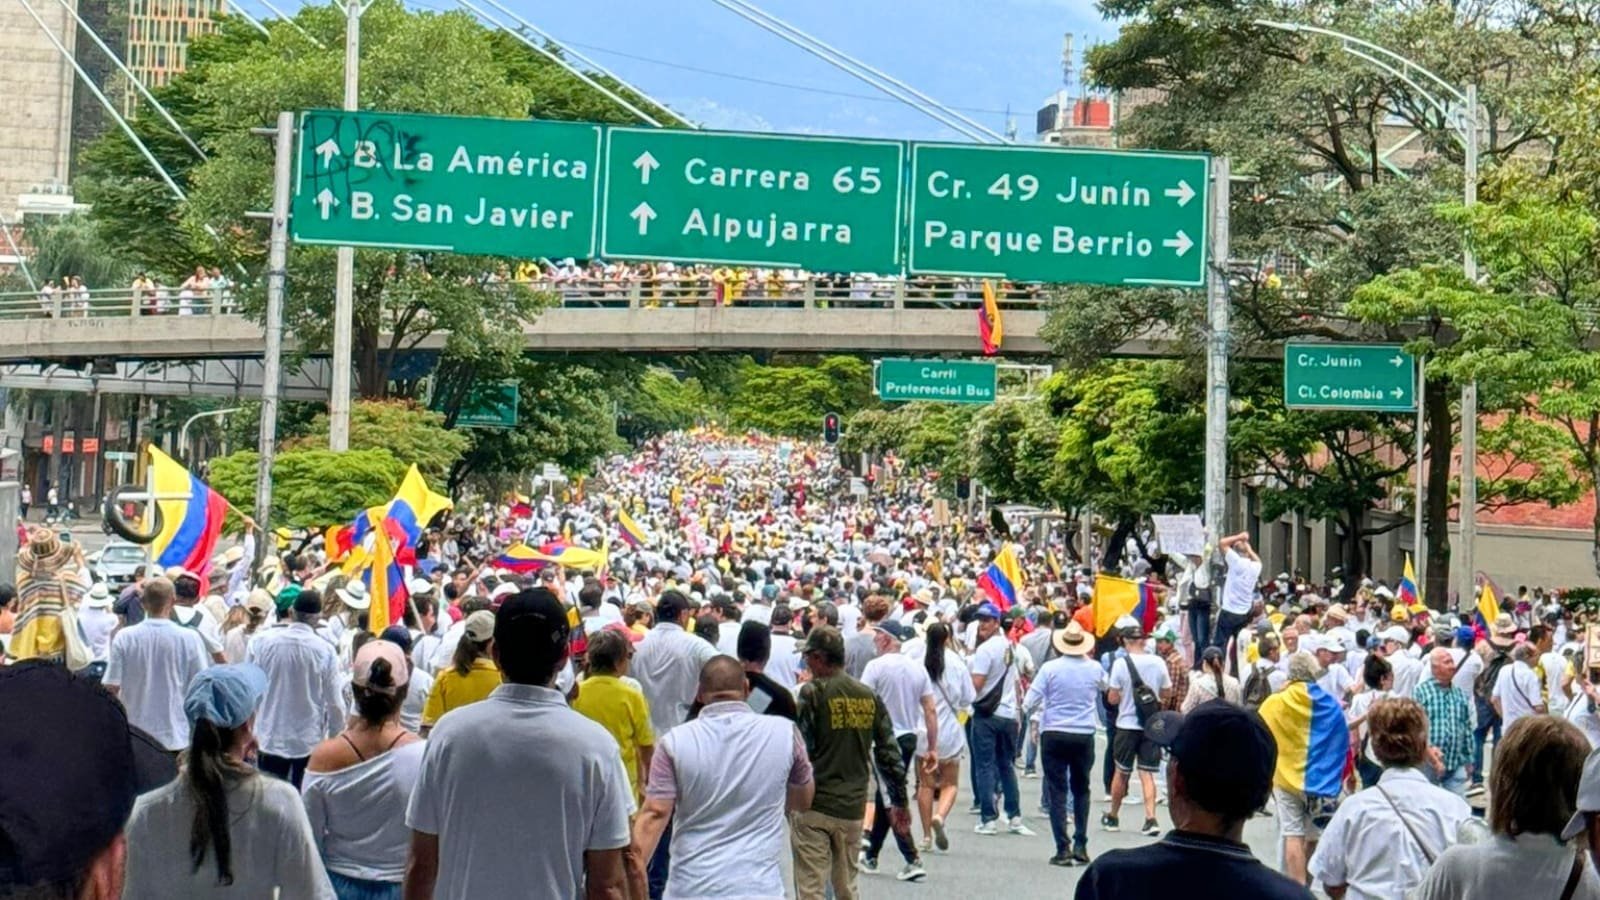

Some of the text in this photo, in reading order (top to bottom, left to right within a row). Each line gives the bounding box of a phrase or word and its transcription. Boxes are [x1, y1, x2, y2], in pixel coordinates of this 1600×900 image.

[353, 139, 588, 180] B. La América
[684, 157, 882, 194] Carrera 65
[927, 170, 1150, 207] Cr. 49 Junín
[350, 191, 573, 230] B. San Javier
[682, 207, 851, 247] Alpujarra
[924, 220, 1152, 257] Parque Berrio
[1297, 353, 1318, 367] Cr.
[886, 382, 991, 397] Preferencial Bus
[1298, 385, 1383, 400] Cl. Colombia
